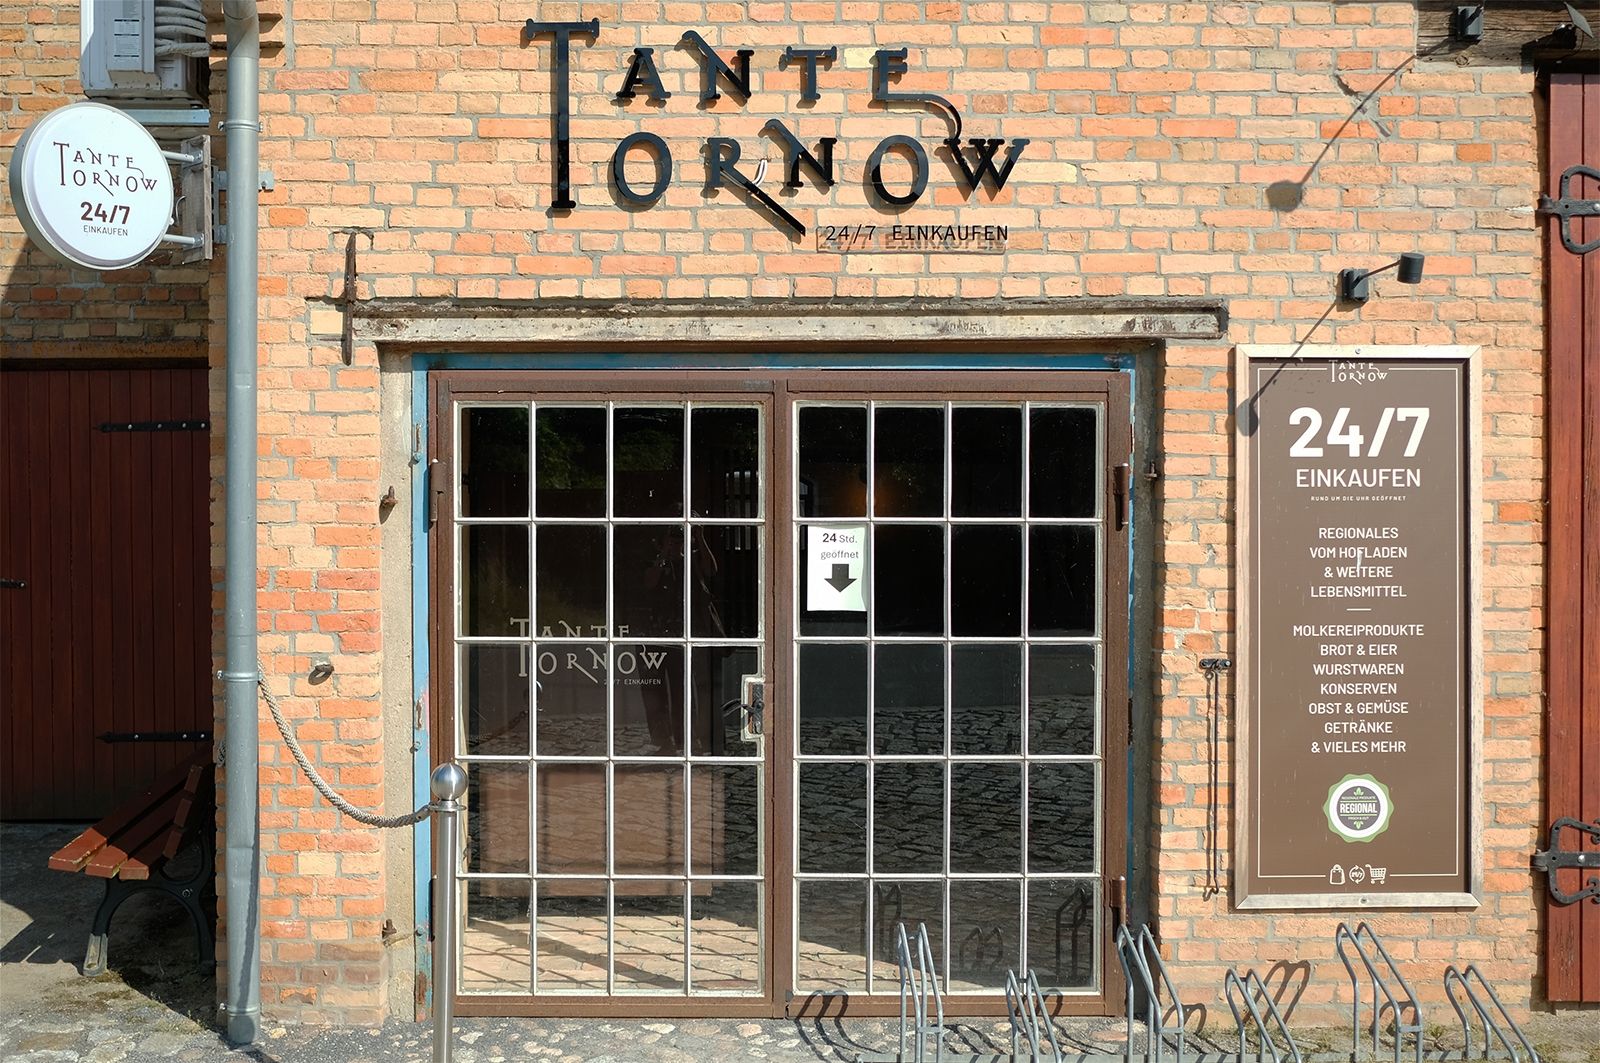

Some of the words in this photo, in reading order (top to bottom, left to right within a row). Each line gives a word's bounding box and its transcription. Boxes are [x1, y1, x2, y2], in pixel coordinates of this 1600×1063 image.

[525, 17, 962, 140] TANTE
[53, 141, 145, 179] TANTE
[80, 201, 131, 225] 24/7
[83, 224, 129, 237] EINKAUFEN
[825, 224, 877, 244] 24/7
[892, 225, 1008, 241] EINKAUFEN
[1328, 359, 1380, 373] TANTE
[1288, 407, 1430, 458] 24/7
[1296, 468, 1421, 488] EINKAUFEN
[822, 532, 837, 543] 24
[839, 534, 858, 543] Std.
[1318, 527, 1399, 540] REGIONALES
[820, 550, 859, 560] geöffnet
[1310, 547, 1337, 559] VOM
[1339, 547, 1408, 559] HOFLADEN
[1324, 566, 1334, 578] &
[1336, 566, 1394, 578] WEITERE
[1310, 586, 1407, 597] LEBENSMITTEL
[1293, 624, 1424, 637] MOLKEREIPRODUKTE
[1320, 644, 1354, 656] BROT
[1356, 644, 1366, 656] &
[1369, 644, 1398, 656] EIER
[1313, 663, 1404, 675] WURSTWAREN
[1320, 683, 1397, 695] KONSERVEN
[1308, 702, 1342, 715] OBST
[1344, 702, 1354, 714] &
[1357, 700, 1409, 714] GEMÜSE
[1324, 719, 1393, 734] GETRÄNKE
[1311, 742, 1321, 753] &
[1323, 741, 1368, 753] VIELES
[1371, 741, 1406, 753] MEHR
[1340, 803, 1377, 813] REGIONAL
